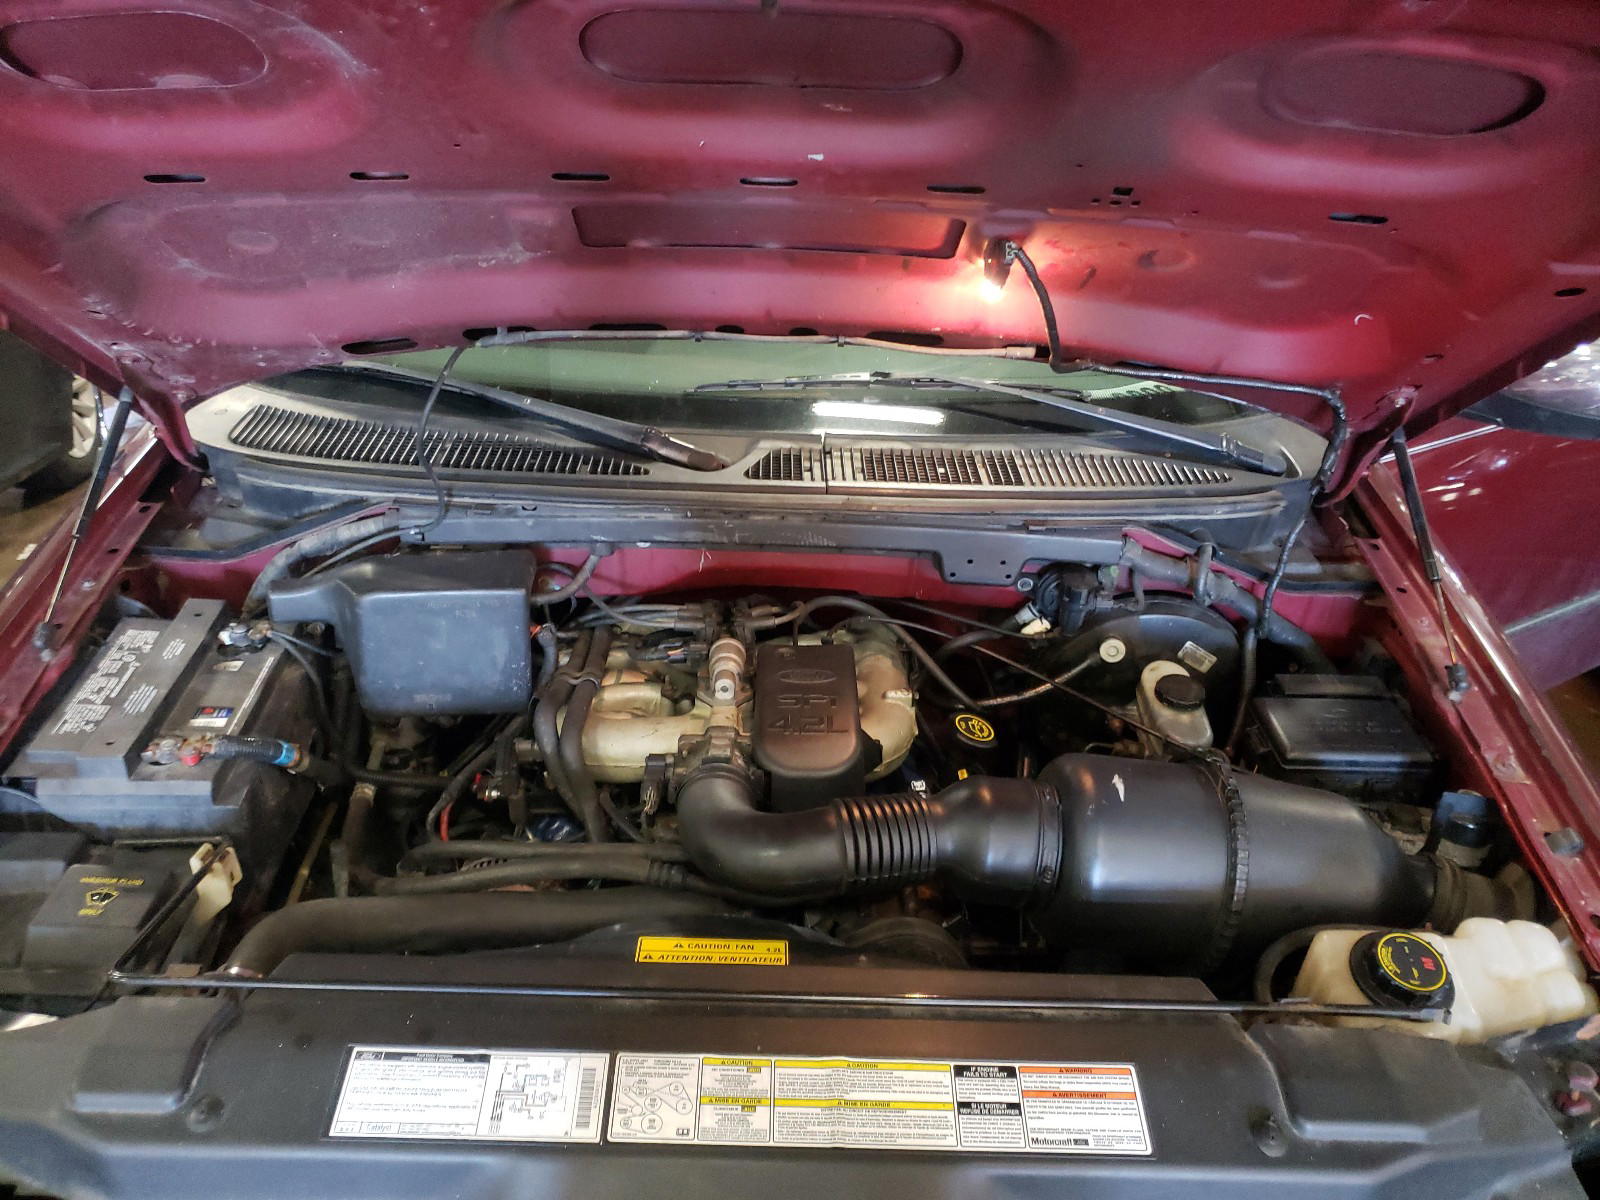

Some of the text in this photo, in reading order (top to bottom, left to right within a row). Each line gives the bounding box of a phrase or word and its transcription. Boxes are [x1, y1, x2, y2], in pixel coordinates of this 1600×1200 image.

[767, 712, 849, 735] 4.2L
[718, 955, 783, 964] VENTILATEUR
[1031, 1137, 1073, 1147] Motorcraft
